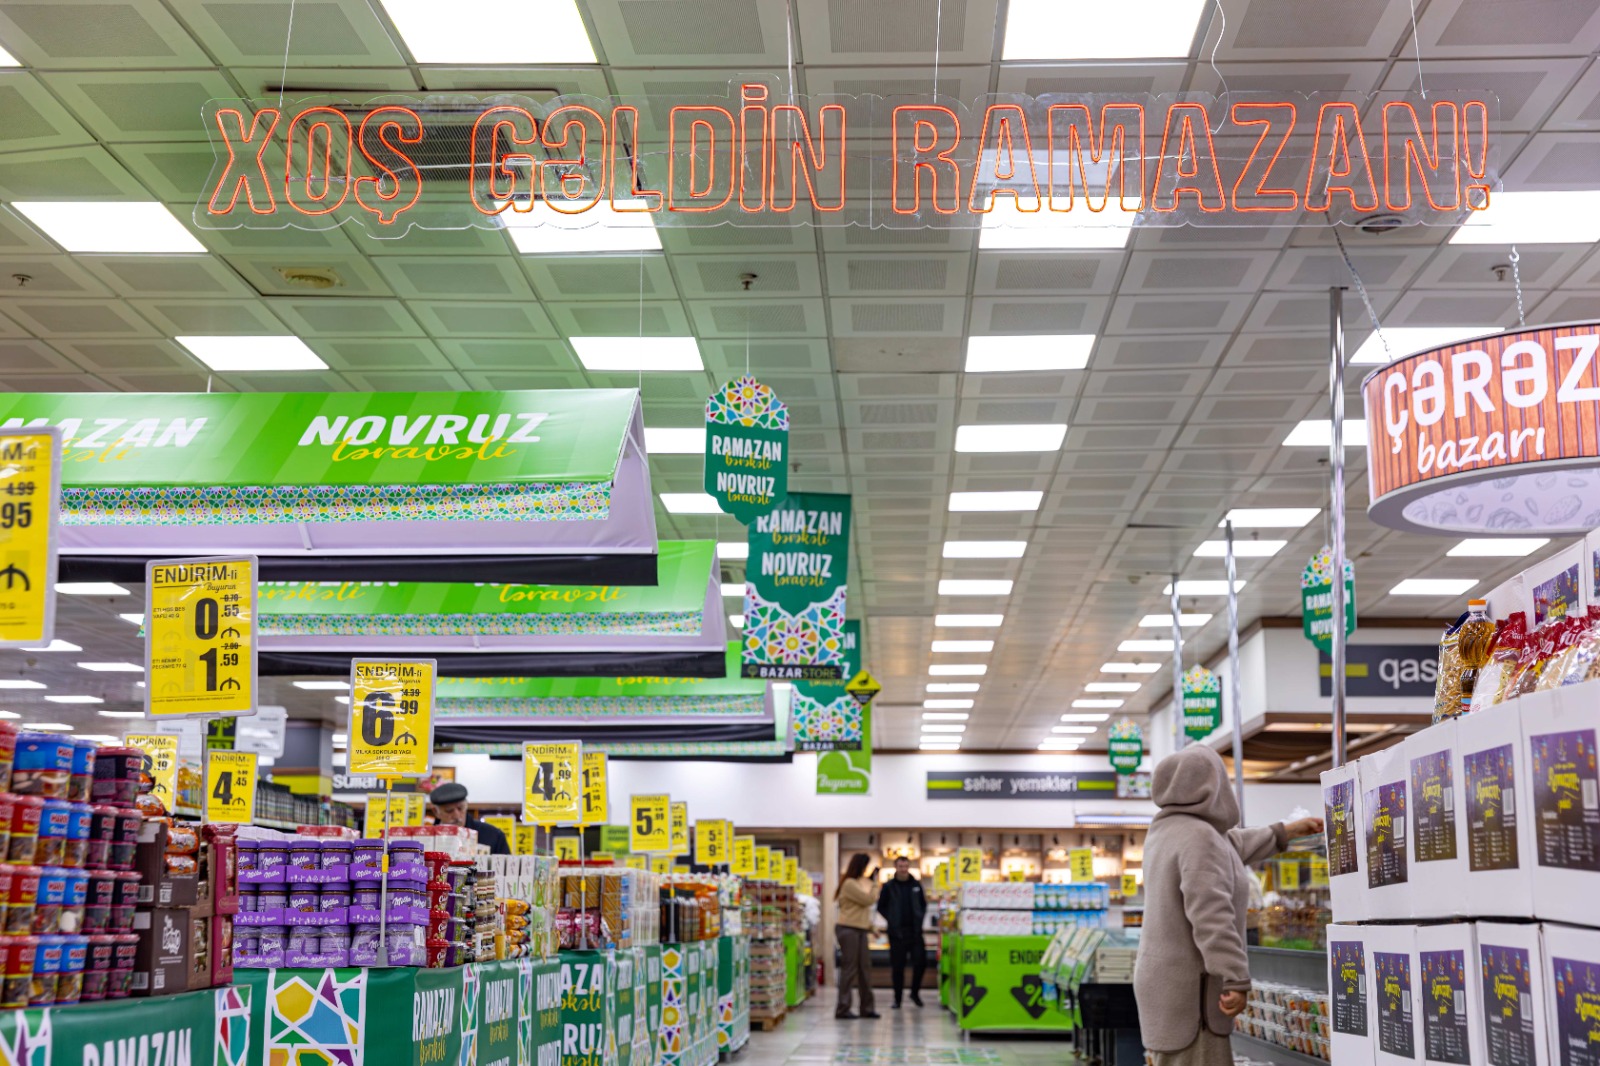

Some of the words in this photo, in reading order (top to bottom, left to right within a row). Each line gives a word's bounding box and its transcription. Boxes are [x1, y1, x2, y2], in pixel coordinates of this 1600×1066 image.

[207, 106, 423, 224] XOŞ
[471, 84, 847, 214] GƏLDİN
[892, 101, 1491, 213] RAMAZAN!
[1384, 334, 1600, 455] ÇƏRƏZ
[298, 412, 549, 446] NOVRUZ
[711, 435, 782, 462] RAMAZAN
[1417, 426, 1545, 474] bazarı
[717, 472, 775, 497] NOVRUZ
[757, 509, 842, 535] RAMAZAN
[761, 551, 833, 577] NOVRUZ
[195, 598, 219, 640] 0
[199, 648, 217, 691] 1
[220, 653, 239, 666] .59
[362, 690, 396, 747] 6
[396, 700, 419, 715] .99
[213, 771, 232, 805] 4
[532, 762, 556, 801] 4
[636, 807, 653, 836] 5
[412, 988, 455, 1042] RAMAZAN
